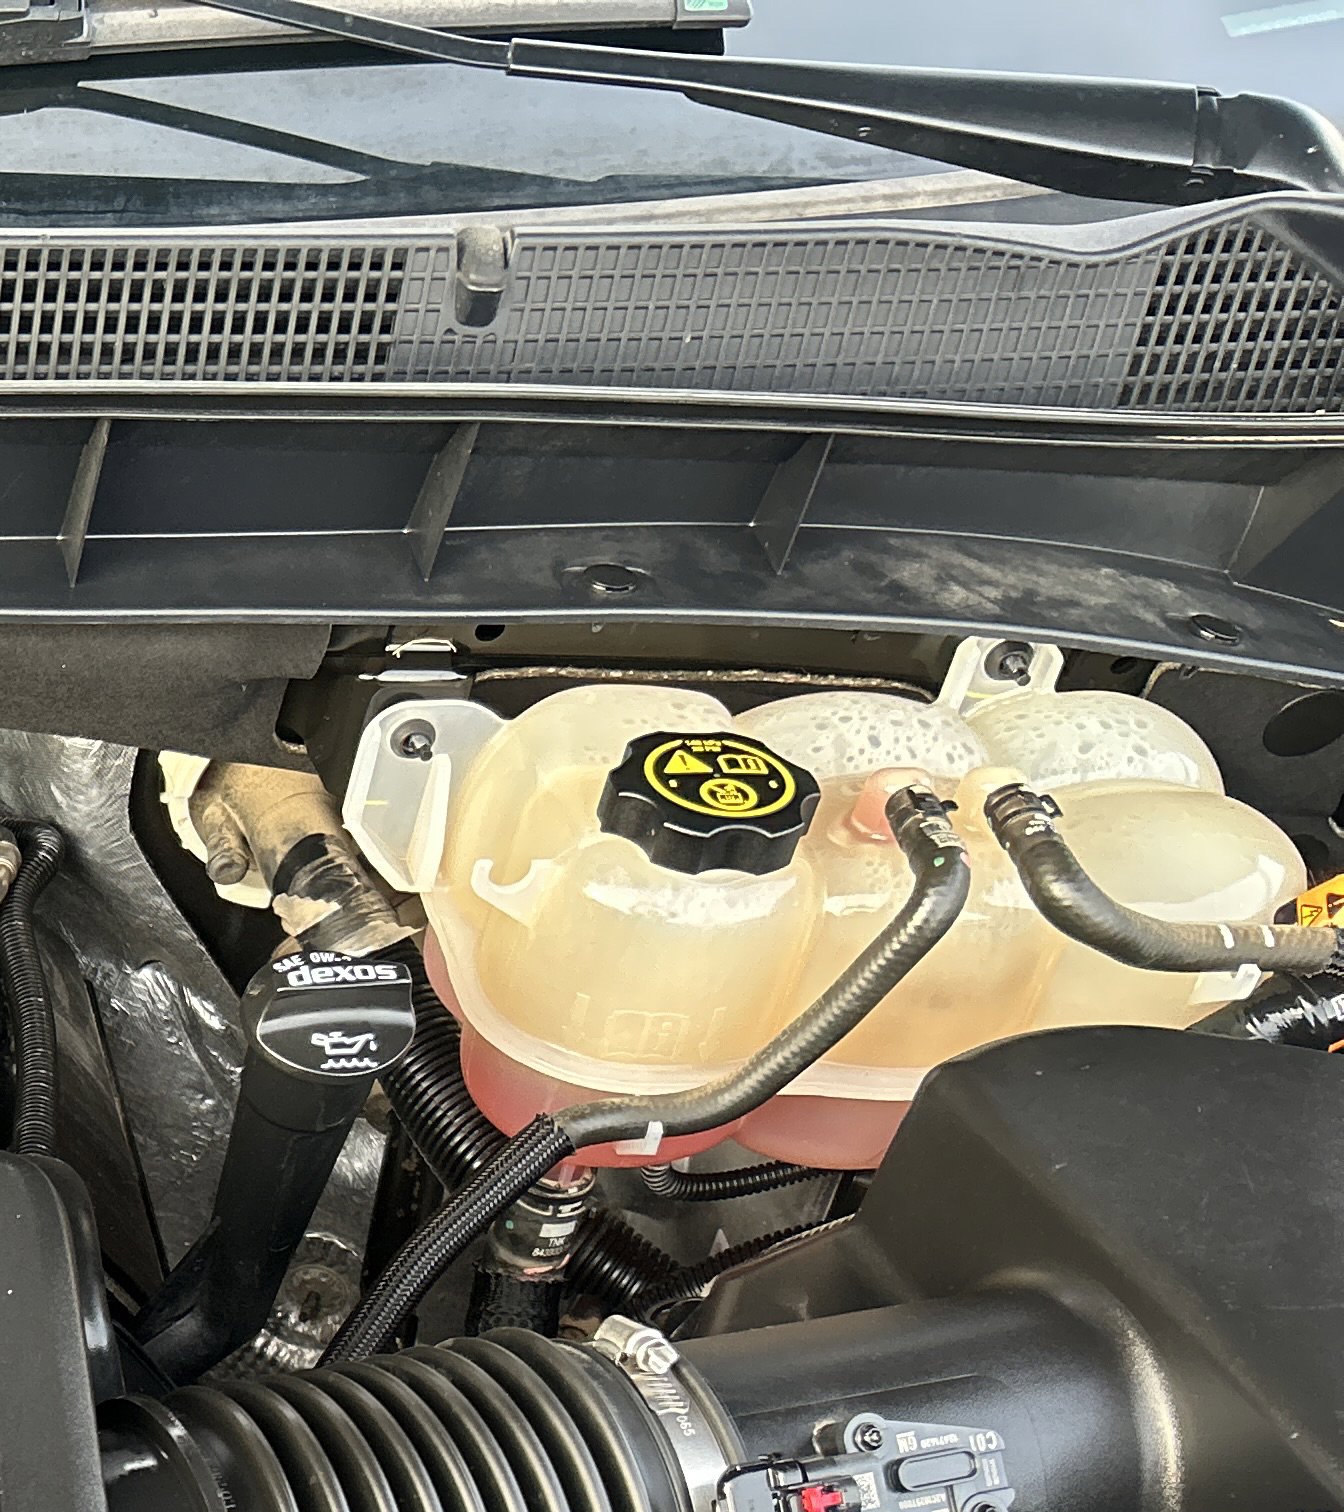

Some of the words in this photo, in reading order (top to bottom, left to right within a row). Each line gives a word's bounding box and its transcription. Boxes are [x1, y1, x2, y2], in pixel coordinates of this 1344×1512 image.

[273, 954, 305, 972] SAE
[287, 964, 398, 987] dexos
[676, 1415, 696, 1437] 065
[896, 1432, 918, 1454] GM
[969, 1430, 998, 1452] C01
